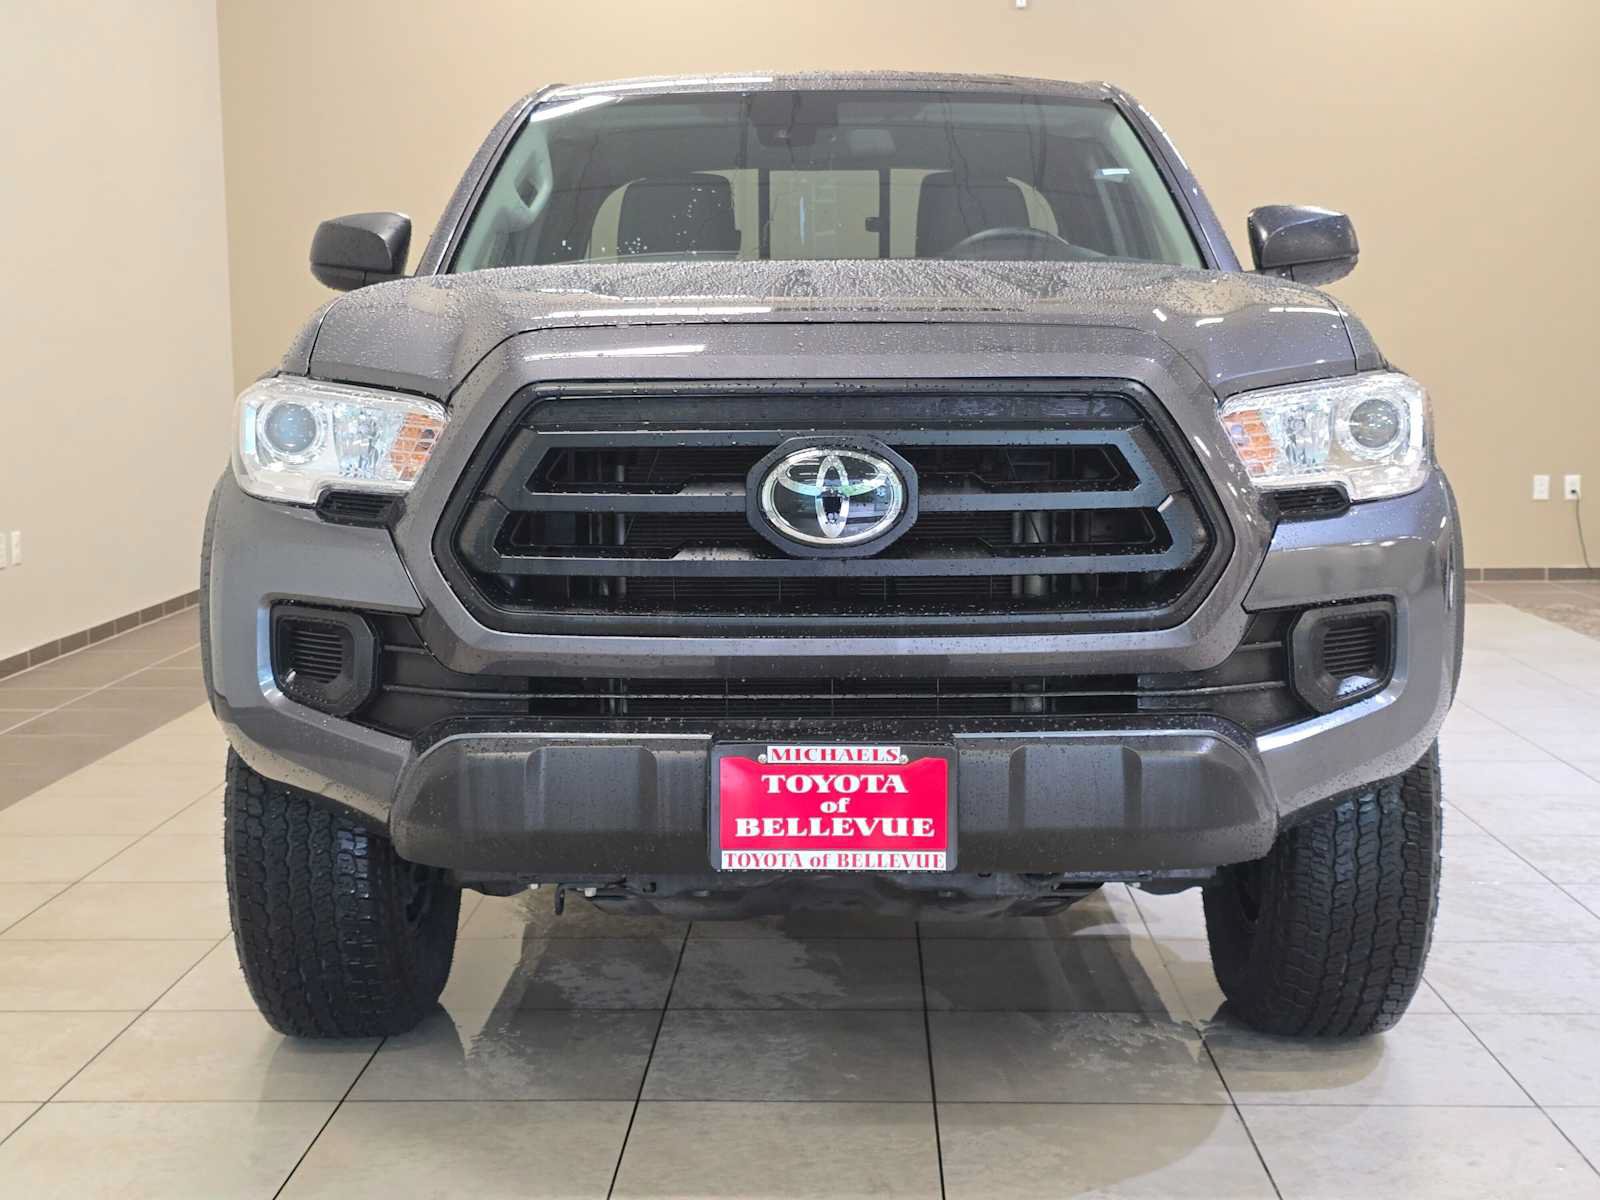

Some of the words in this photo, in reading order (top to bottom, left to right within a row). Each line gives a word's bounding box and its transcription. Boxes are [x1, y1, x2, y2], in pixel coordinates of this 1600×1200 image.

[770, 748, 898, 761] MICHAELS
[762, 774, 909, 794] TOYOTA
[820, 797, 851, 814] of
[735, 818, 935, 837] BELLEVUE
[724, 852, 803, 868] TOYOTA
[810, 852, 829, 868] of
[837, 852, 945, 868] BELLEVUE
